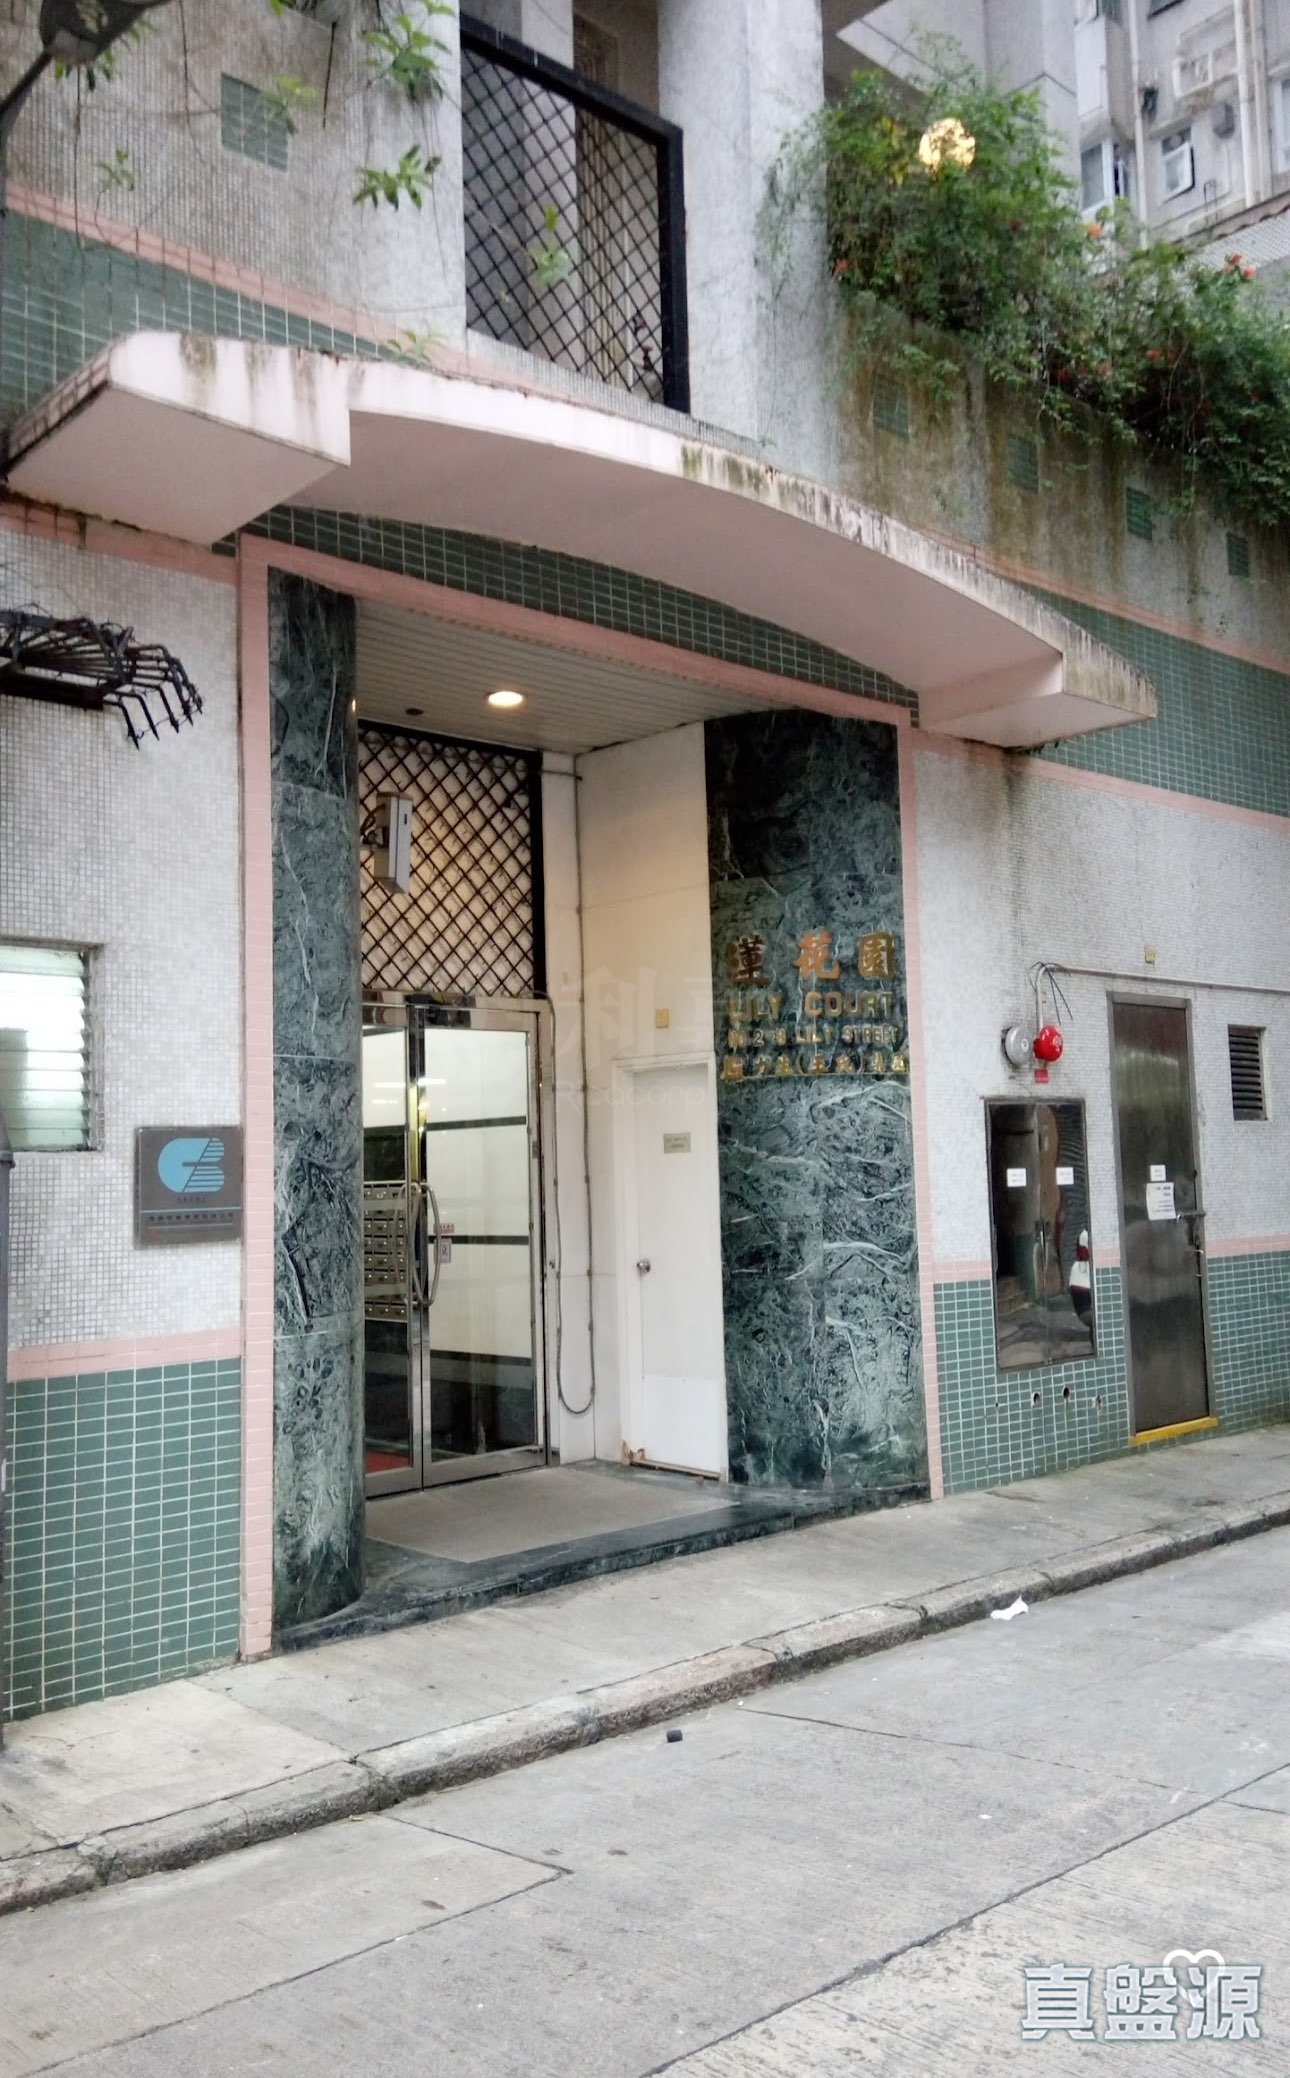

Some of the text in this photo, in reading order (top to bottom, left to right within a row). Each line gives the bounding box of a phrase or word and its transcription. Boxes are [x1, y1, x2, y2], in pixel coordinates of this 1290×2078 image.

[729, 990, 893, 1020] LILY COURT
[795, 1023, 835, 1044] LILY
[842, 1023, 898, 1045] STREET
